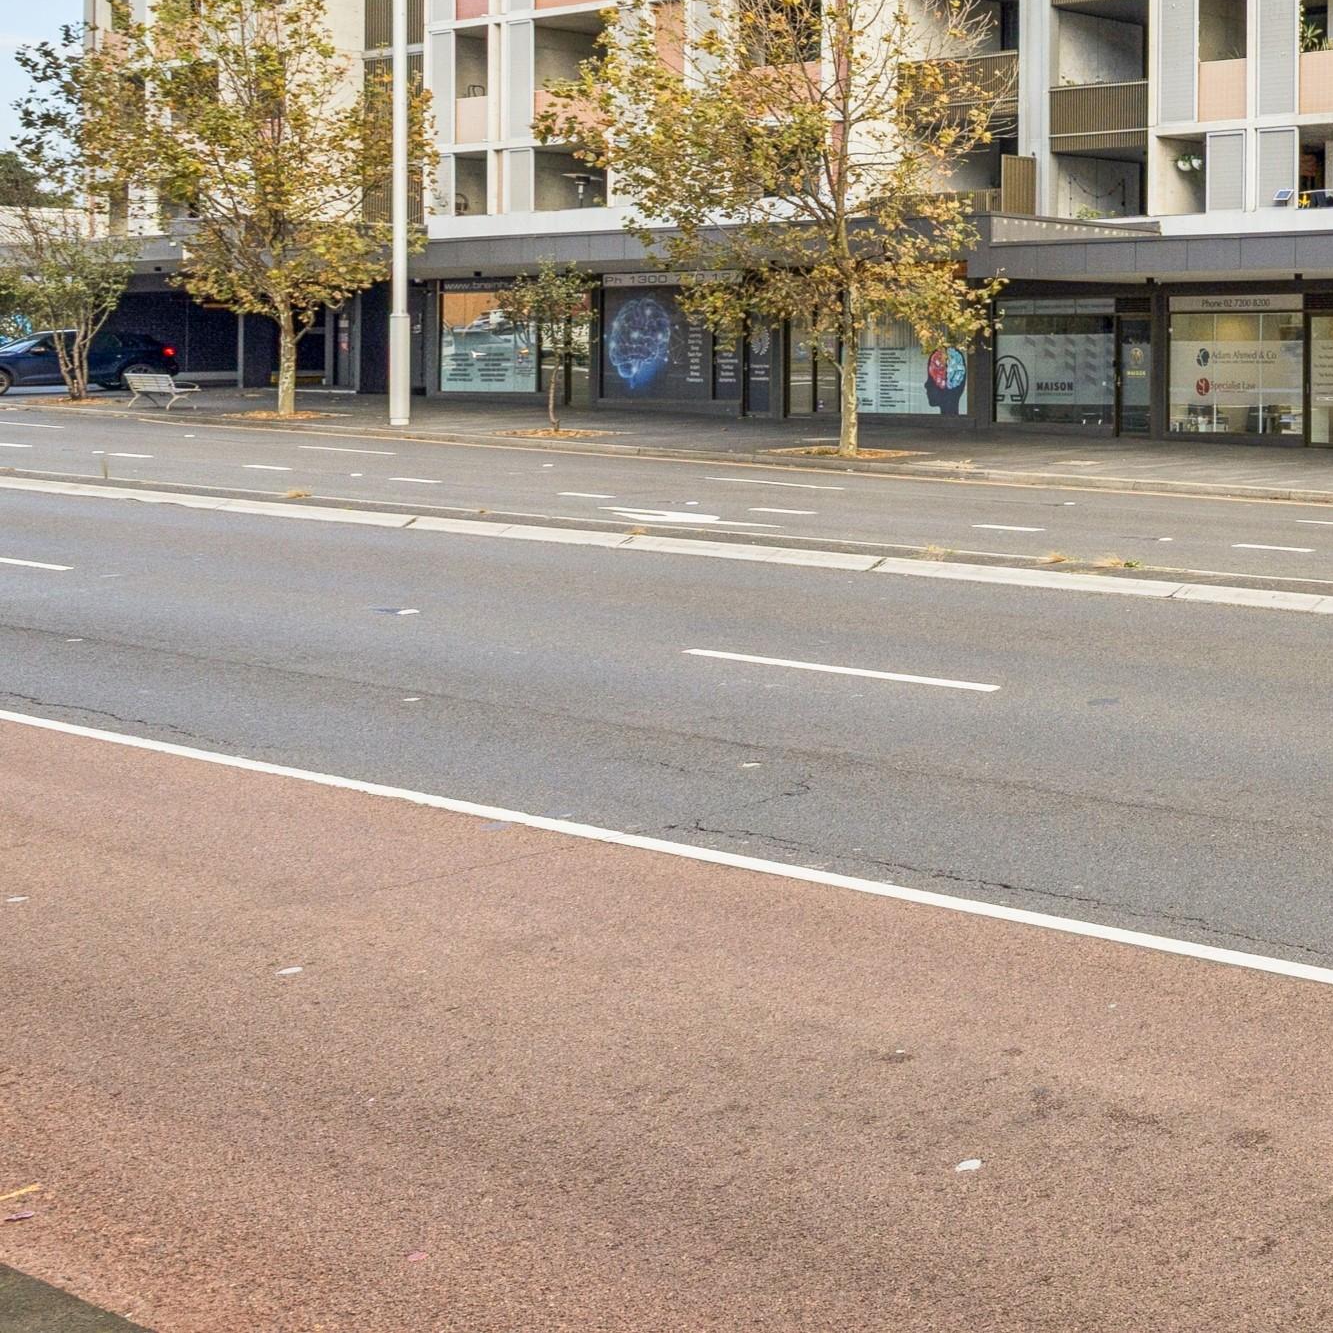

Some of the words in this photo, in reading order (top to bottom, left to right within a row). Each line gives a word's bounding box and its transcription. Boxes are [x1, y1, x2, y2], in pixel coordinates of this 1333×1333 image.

[605, 276, 622, 284] Ph
[630, 274, 668, 284] 1300
[1201, 298, 1222, 307] Phone
[1223, 299, 1232, 307] 02
[1234, 299, 1251, 307] 7200
[1253, 298, 1270, 307] 8200
[1233, 350, 1257, 359] Ahmed
[1036, 381, 1073, 391] MAISON
[1210, 381, 1241, 390] Specialist
[1242, 381, 1256, 389] Law
